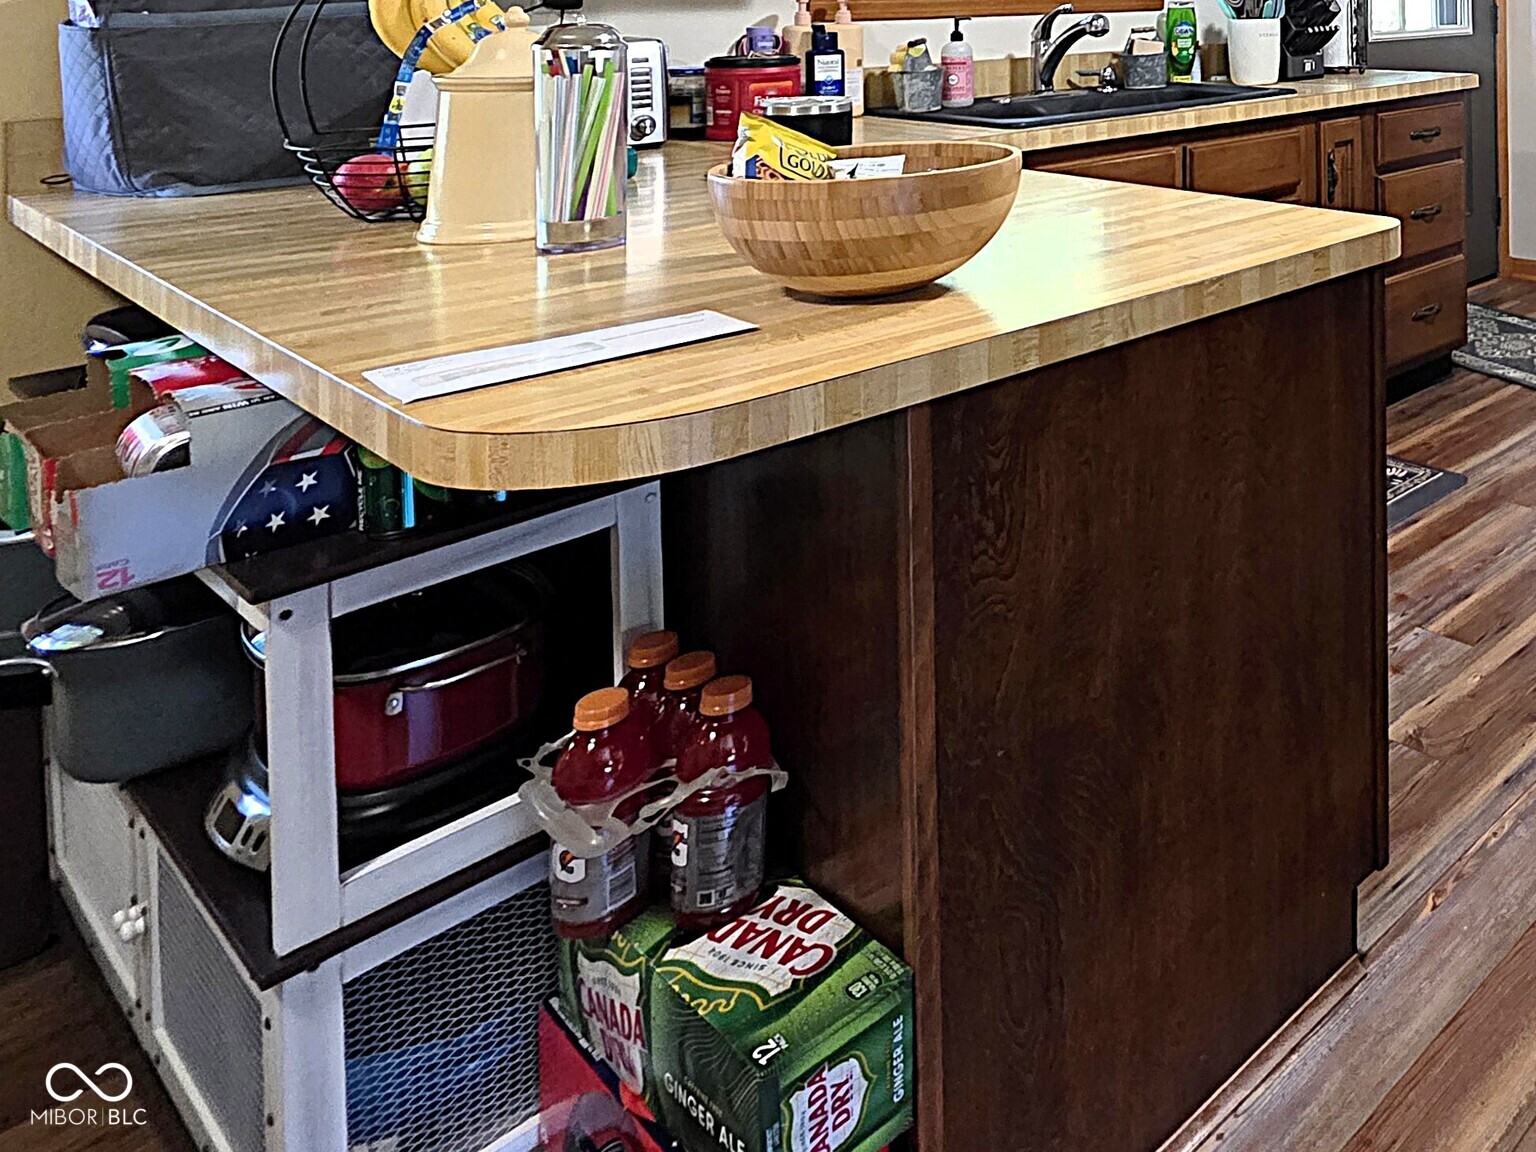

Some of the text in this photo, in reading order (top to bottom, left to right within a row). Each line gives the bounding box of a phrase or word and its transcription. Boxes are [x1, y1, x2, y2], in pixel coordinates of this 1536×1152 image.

[787, 154, 825, 179] GOLD
[96, 566, 135, 590] 12
[749, 895, 837, 935] DRY
[707, 917, 834, 976] CANAD
[729, 958, 768, 972] SINCE
[578, 977, 647, 1050] CANADA
[752, 1038, 781, 1065] 12
[893, 1014, 904, 1103] GINGER ALE
[664, 1072, 715, 1136] GINGER
[807, 1061, 833, 1152] ANADA
[831, 1079, 852, 1132] DRY
